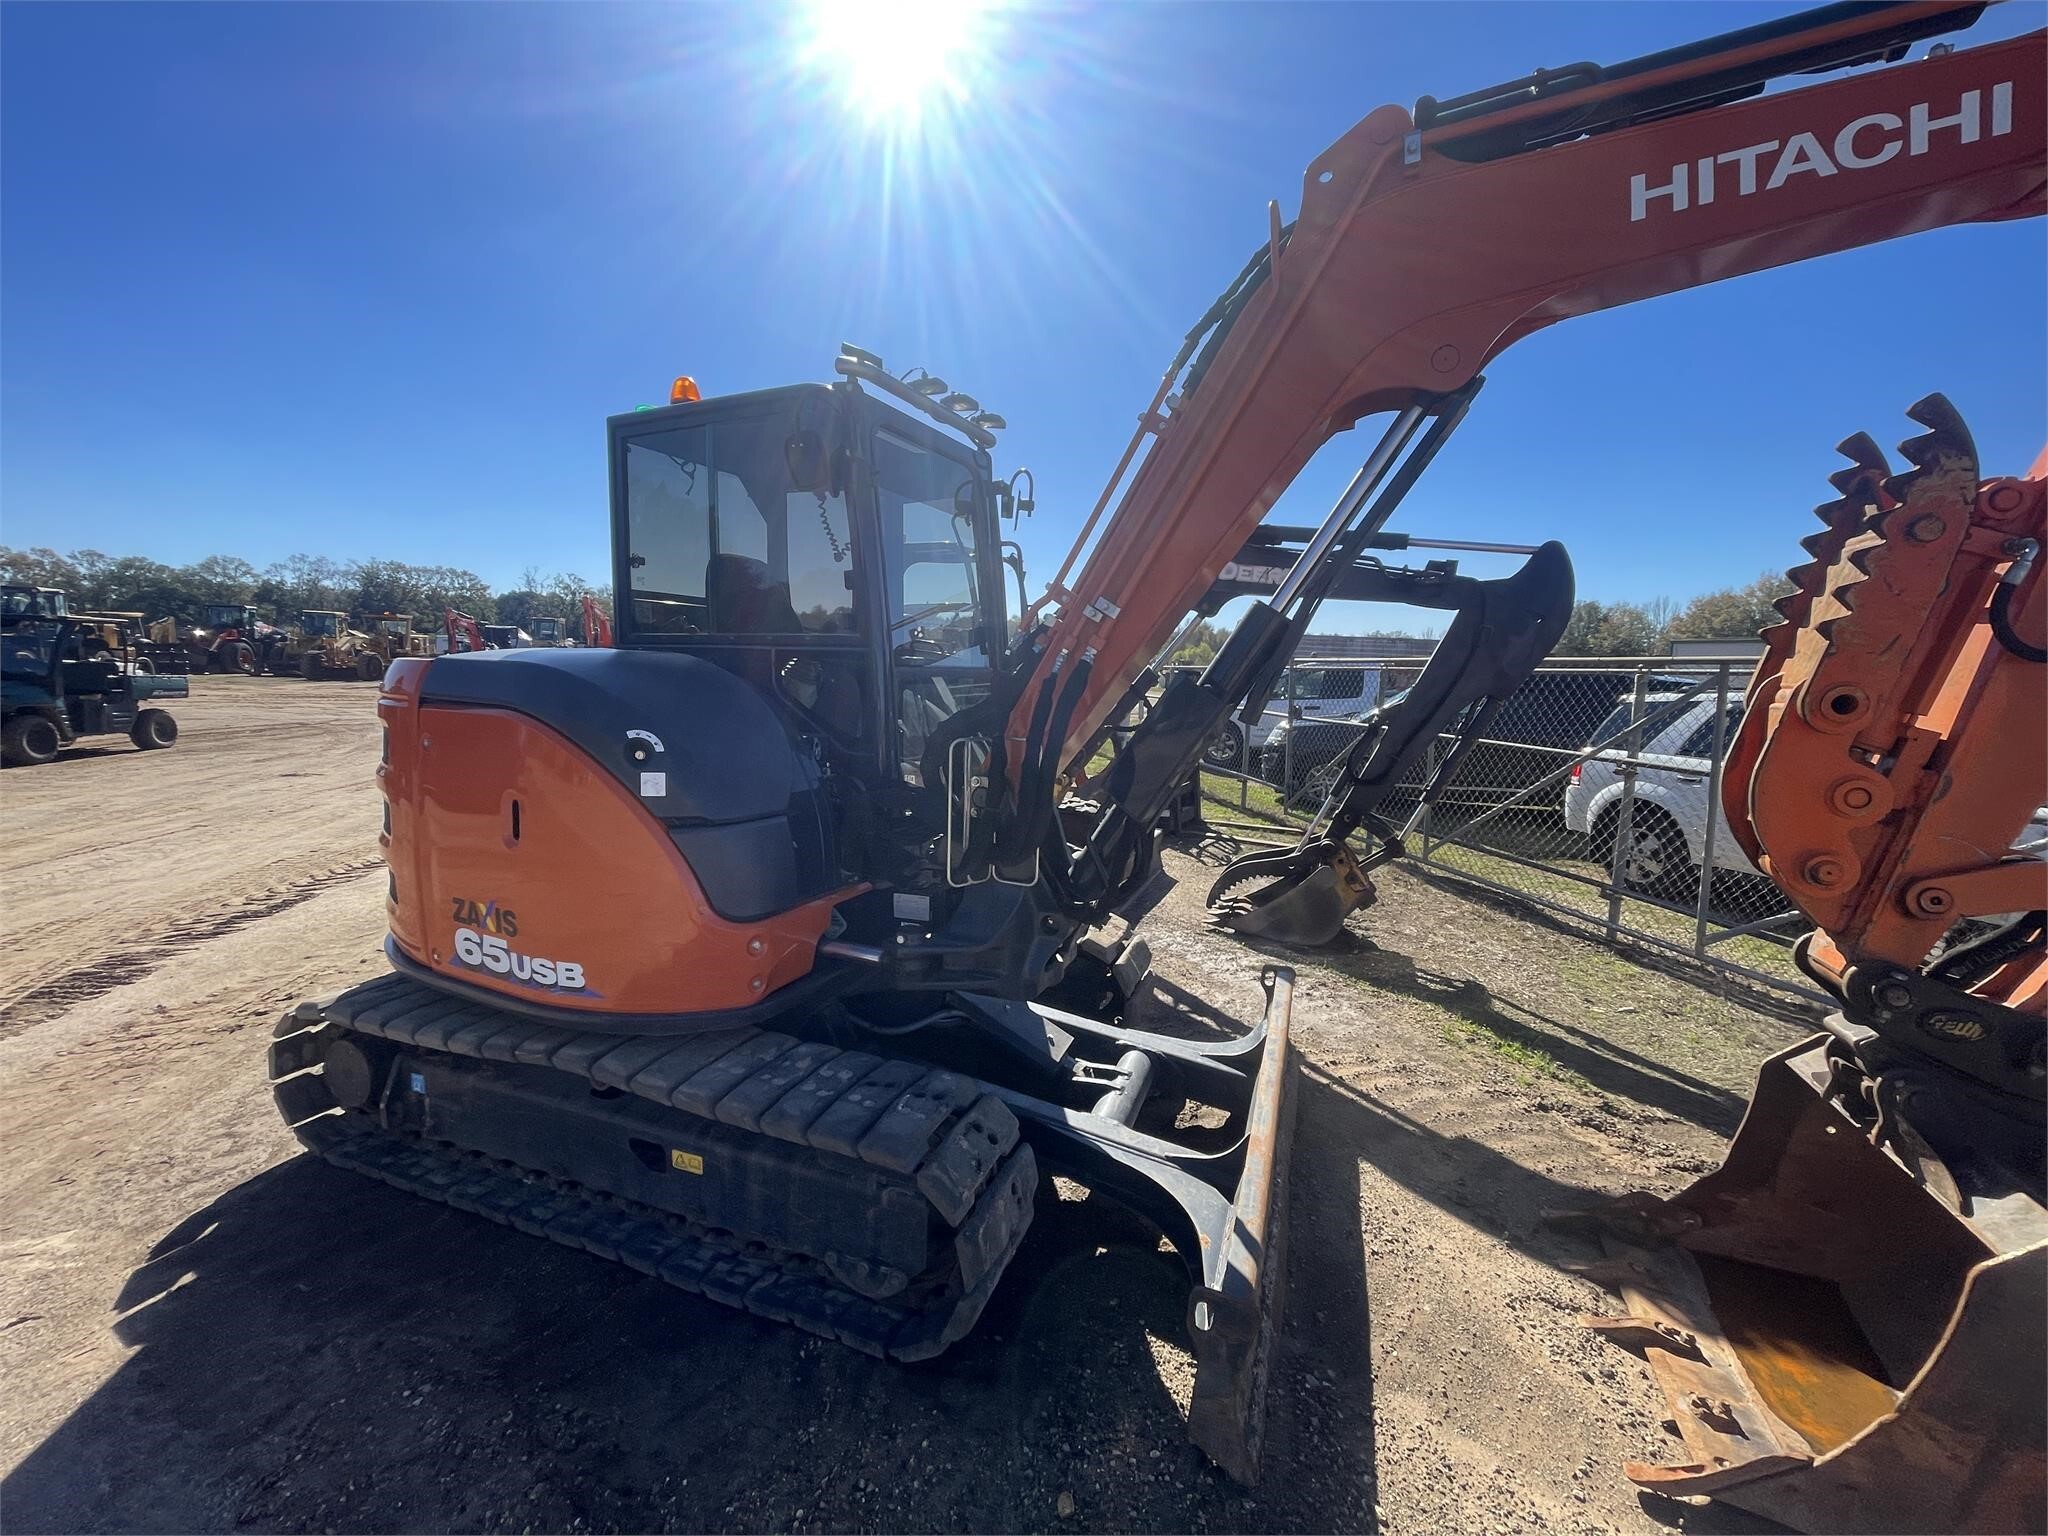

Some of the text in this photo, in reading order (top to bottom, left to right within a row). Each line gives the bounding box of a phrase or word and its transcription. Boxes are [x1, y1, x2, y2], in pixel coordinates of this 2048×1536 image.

[1630, 81, 2013, 221] HITACHI
[452, 897, 518, 937] ZAXIS
[454, 928, 585, 989] 65USB
